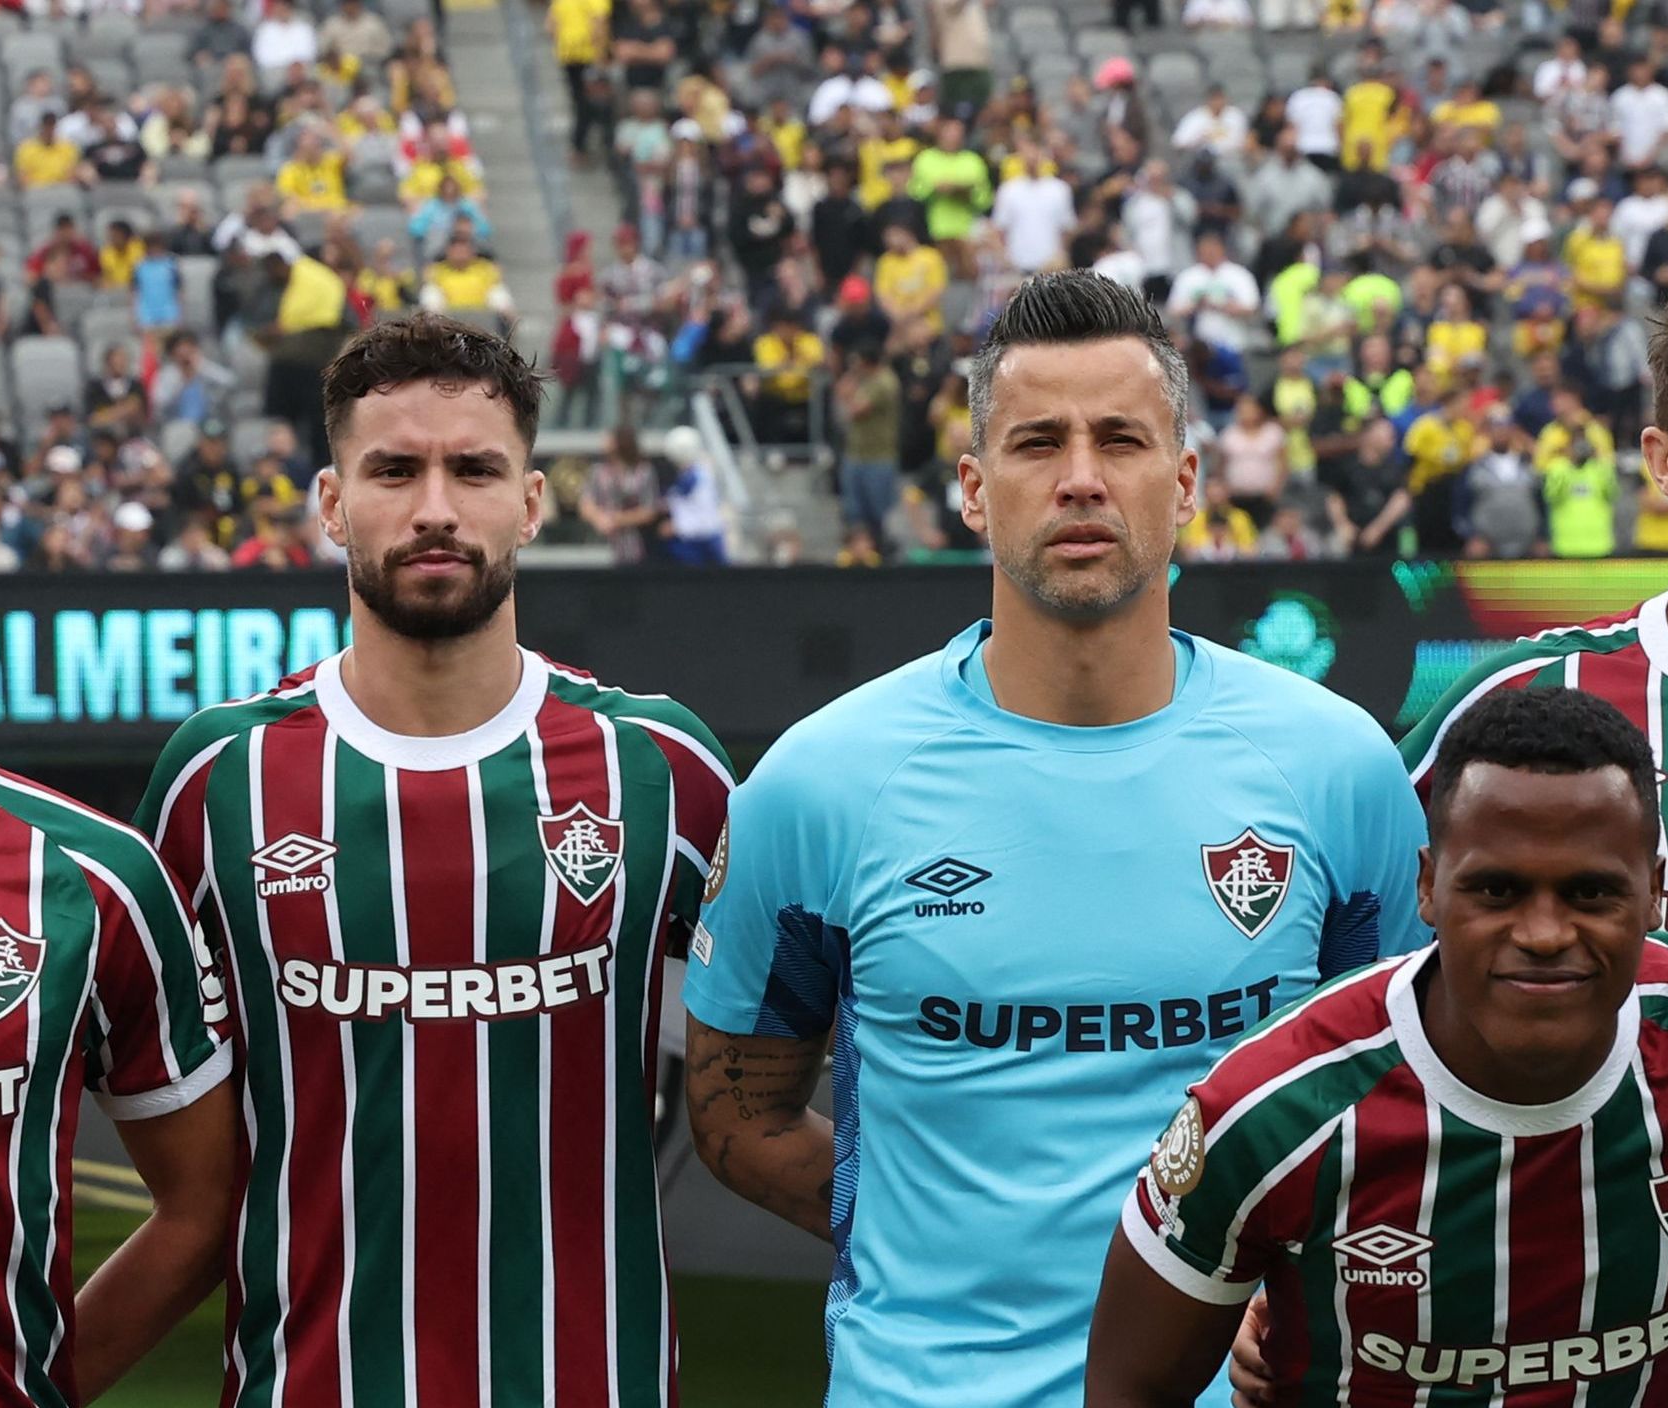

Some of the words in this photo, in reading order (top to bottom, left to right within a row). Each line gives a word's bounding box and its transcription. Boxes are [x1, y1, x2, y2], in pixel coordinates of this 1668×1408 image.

[259, 874, 331, 897] umbro
[914, 899, 986, 918] umbro
[282, 945, 609, 1020] SUPERBET
[917, 976, 1280, 1053] SUPERBET
[1343, 1267, 1424, 1287] umbro
